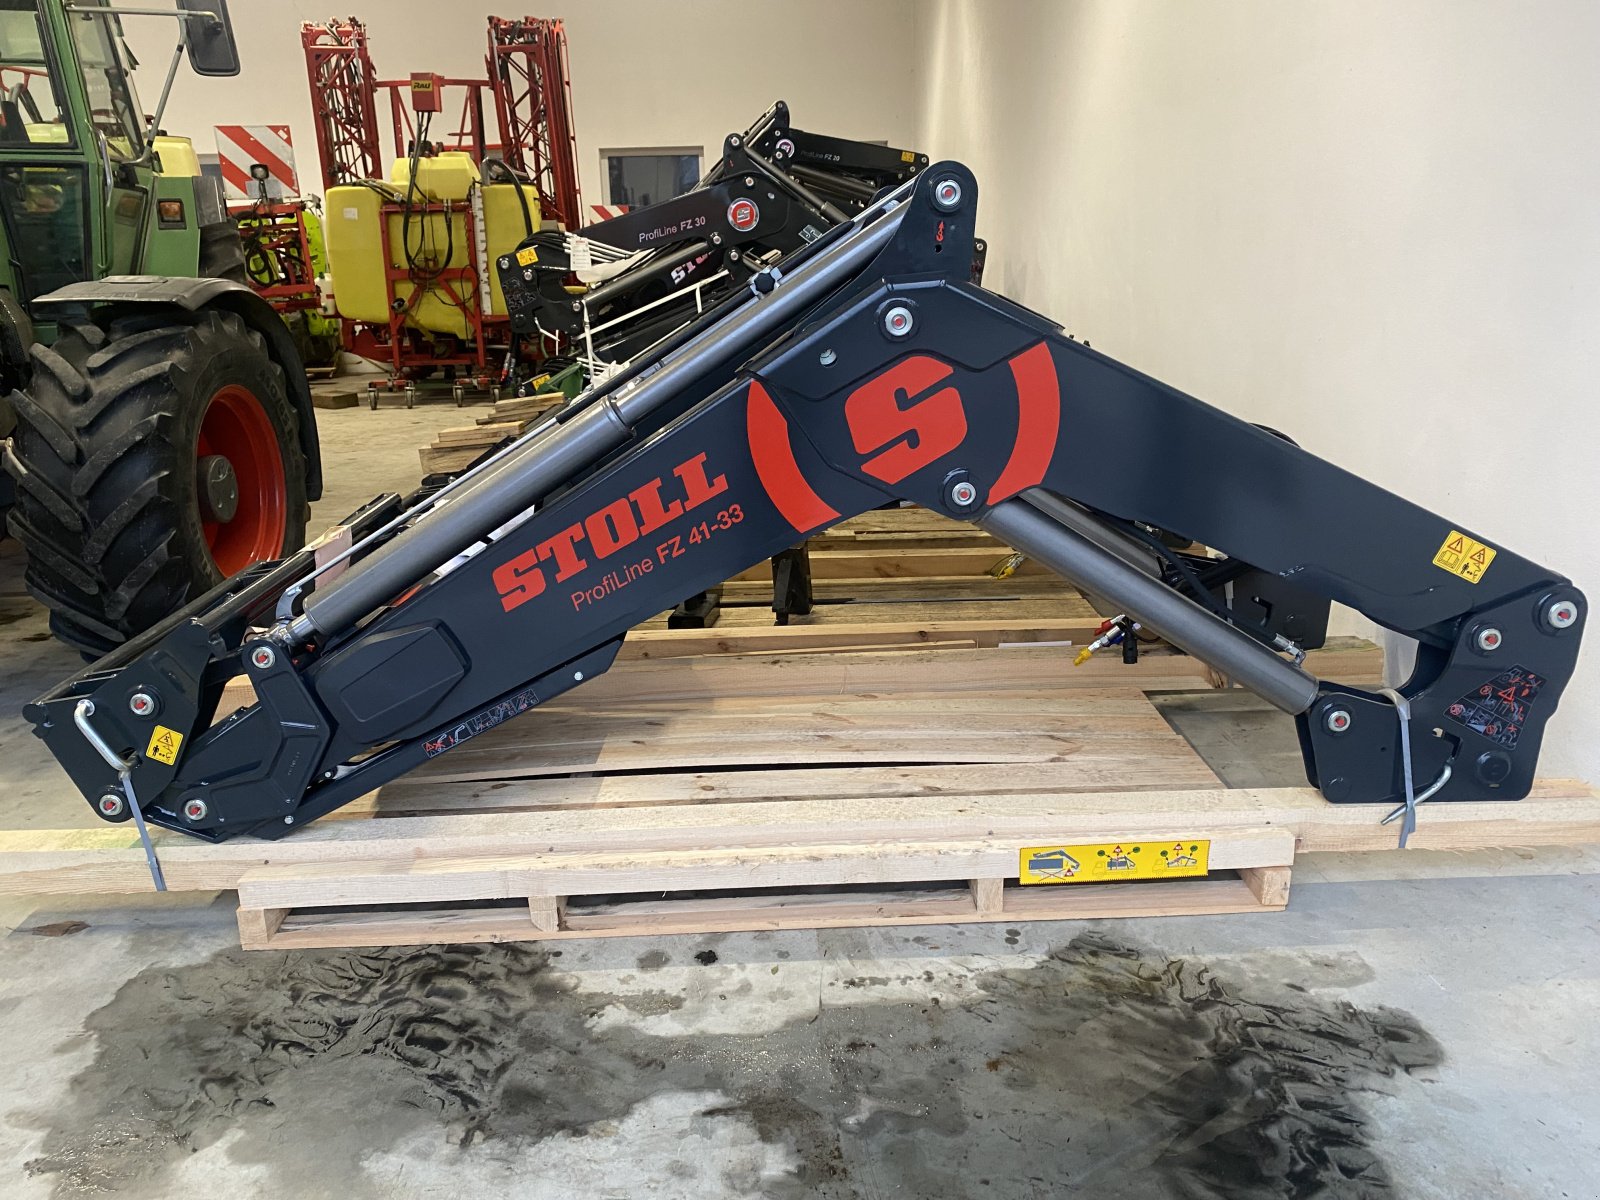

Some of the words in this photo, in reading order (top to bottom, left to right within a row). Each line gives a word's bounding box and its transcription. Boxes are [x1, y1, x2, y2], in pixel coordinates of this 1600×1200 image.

[638, 225, 677, 242] ProfiLine
[680, 219, 693, 231] FZ
[695, 216, 706, 227] 30
[844, 355, 968, 485] S
[492, 452, 728, 613] STOLL
[570, 558, 654, 612] ProfiLine
[655, 535, 686, 565] FZ
[688, 503, 745, 546] 41-33
